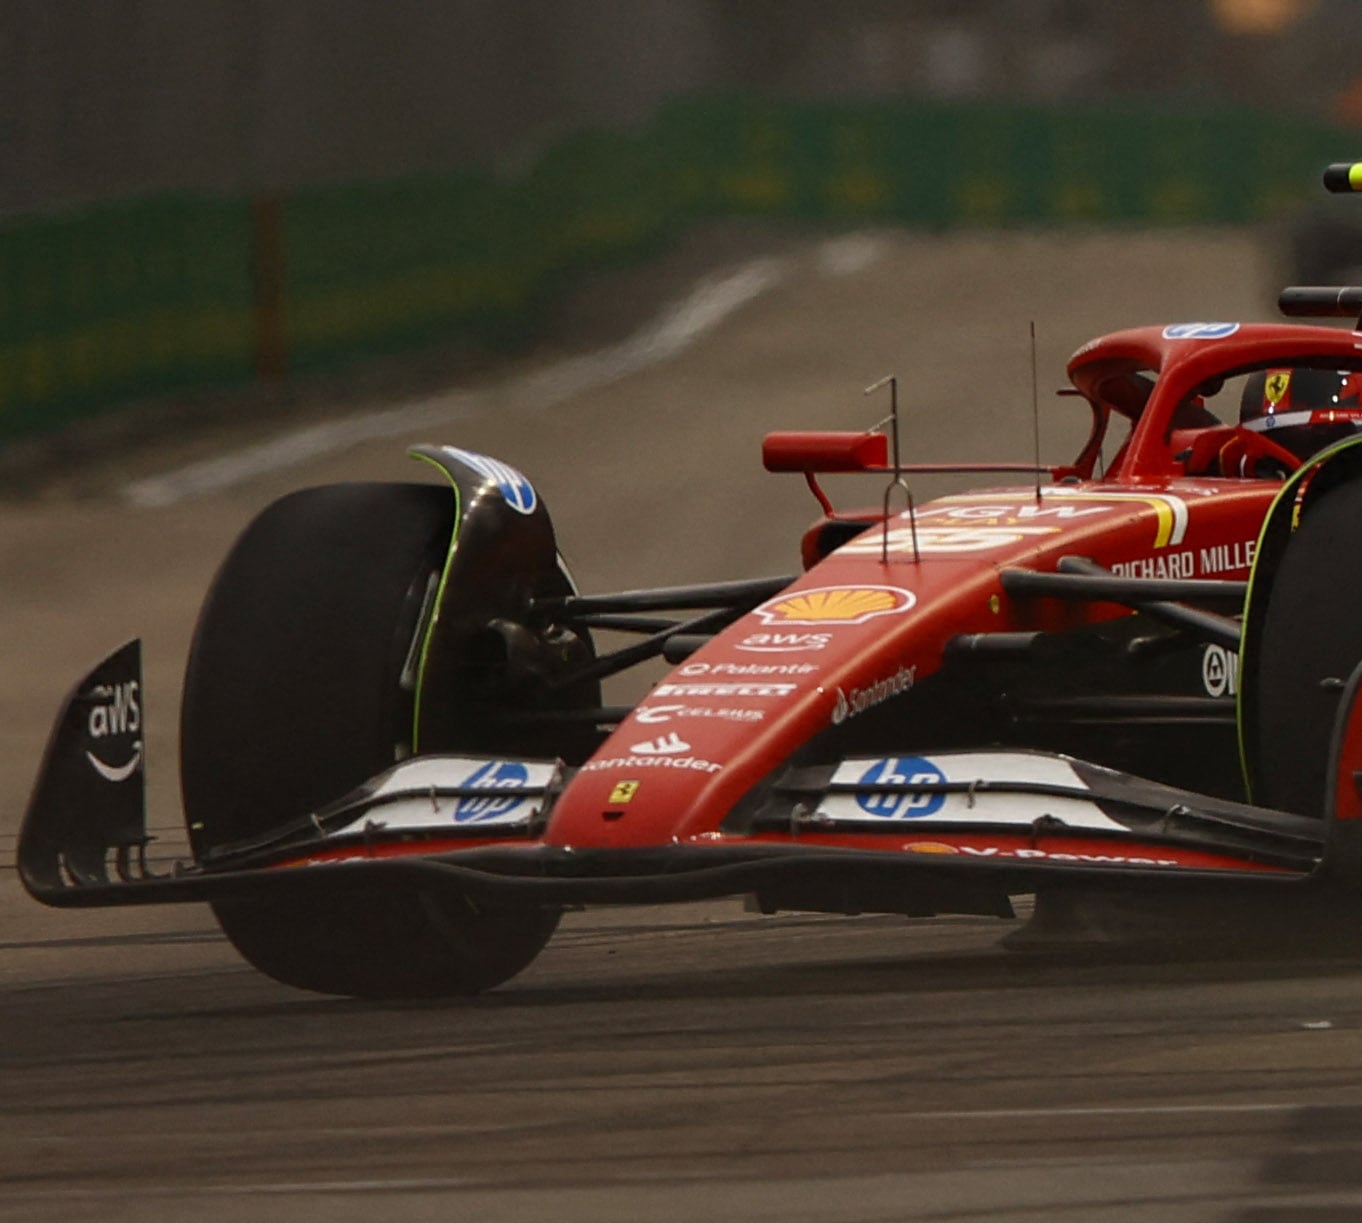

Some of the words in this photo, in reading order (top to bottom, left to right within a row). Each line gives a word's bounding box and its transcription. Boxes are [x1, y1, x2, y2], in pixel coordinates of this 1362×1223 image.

[742, 633, 832, 646] aws
[711, 663, 817, 676] Palantir
[455, 760, 528, 823] hp
[858, 756, 947, 819] hp
